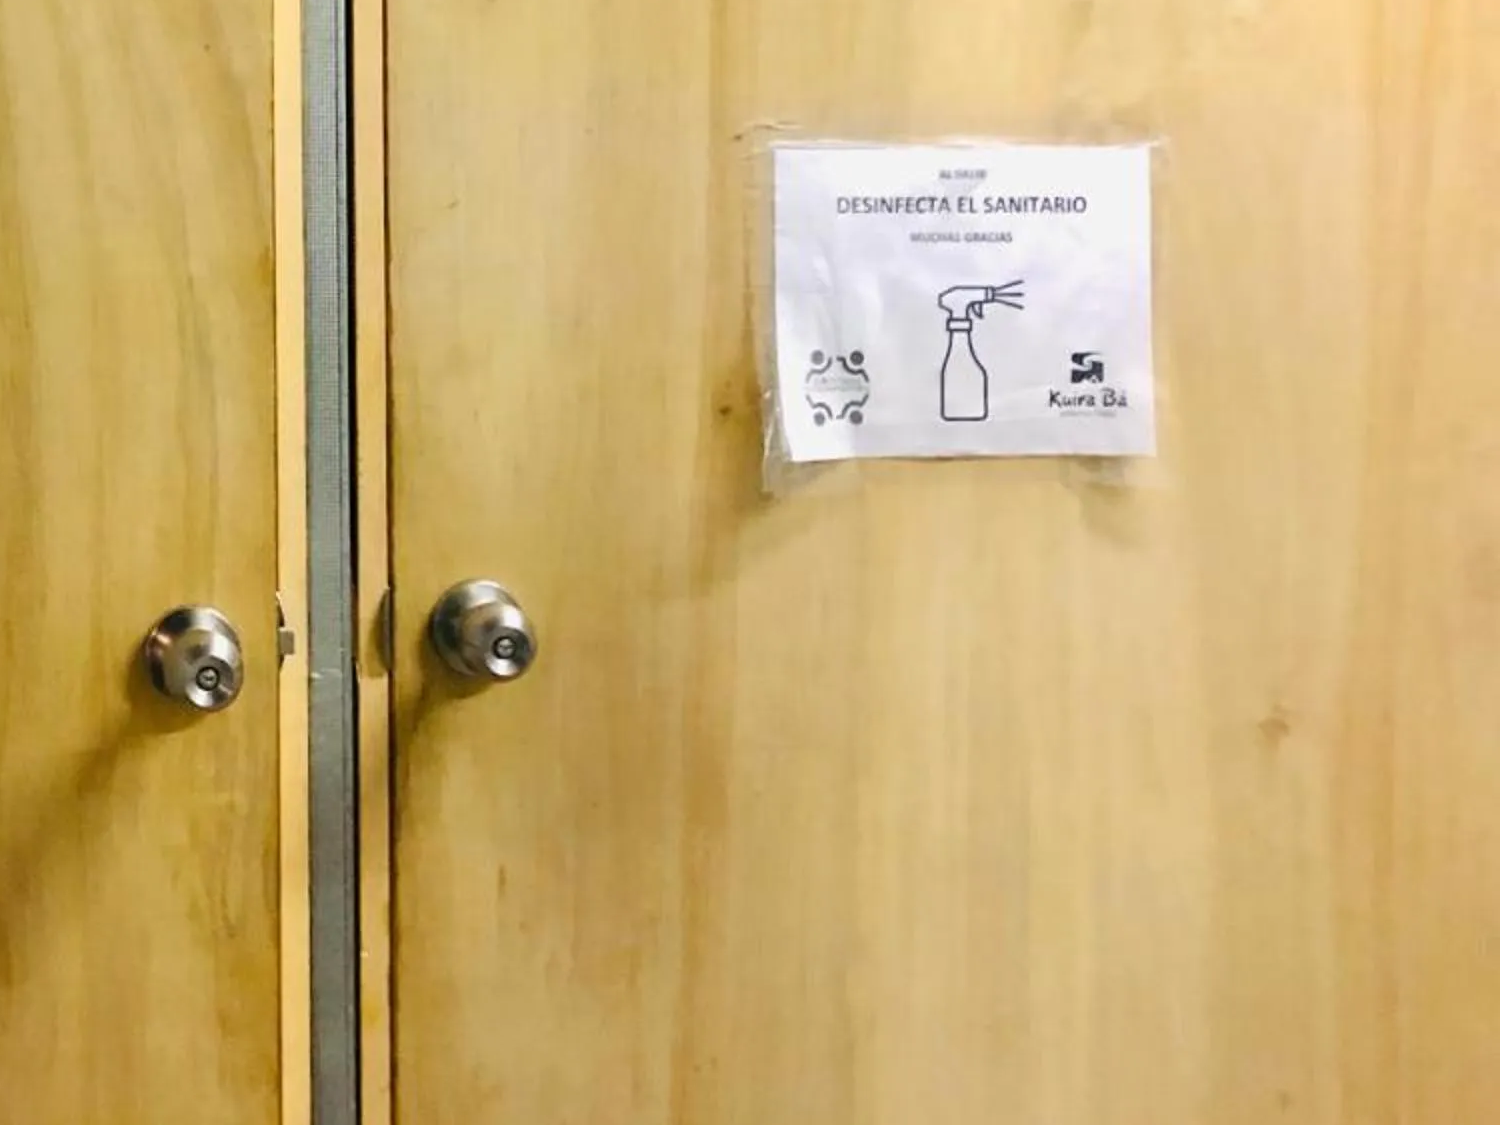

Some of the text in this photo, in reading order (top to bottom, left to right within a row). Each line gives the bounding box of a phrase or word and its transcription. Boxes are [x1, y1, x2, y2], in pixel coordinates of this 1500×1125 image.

[836, 195, 1088, 215] DESINFECTA EL SANITARIO
